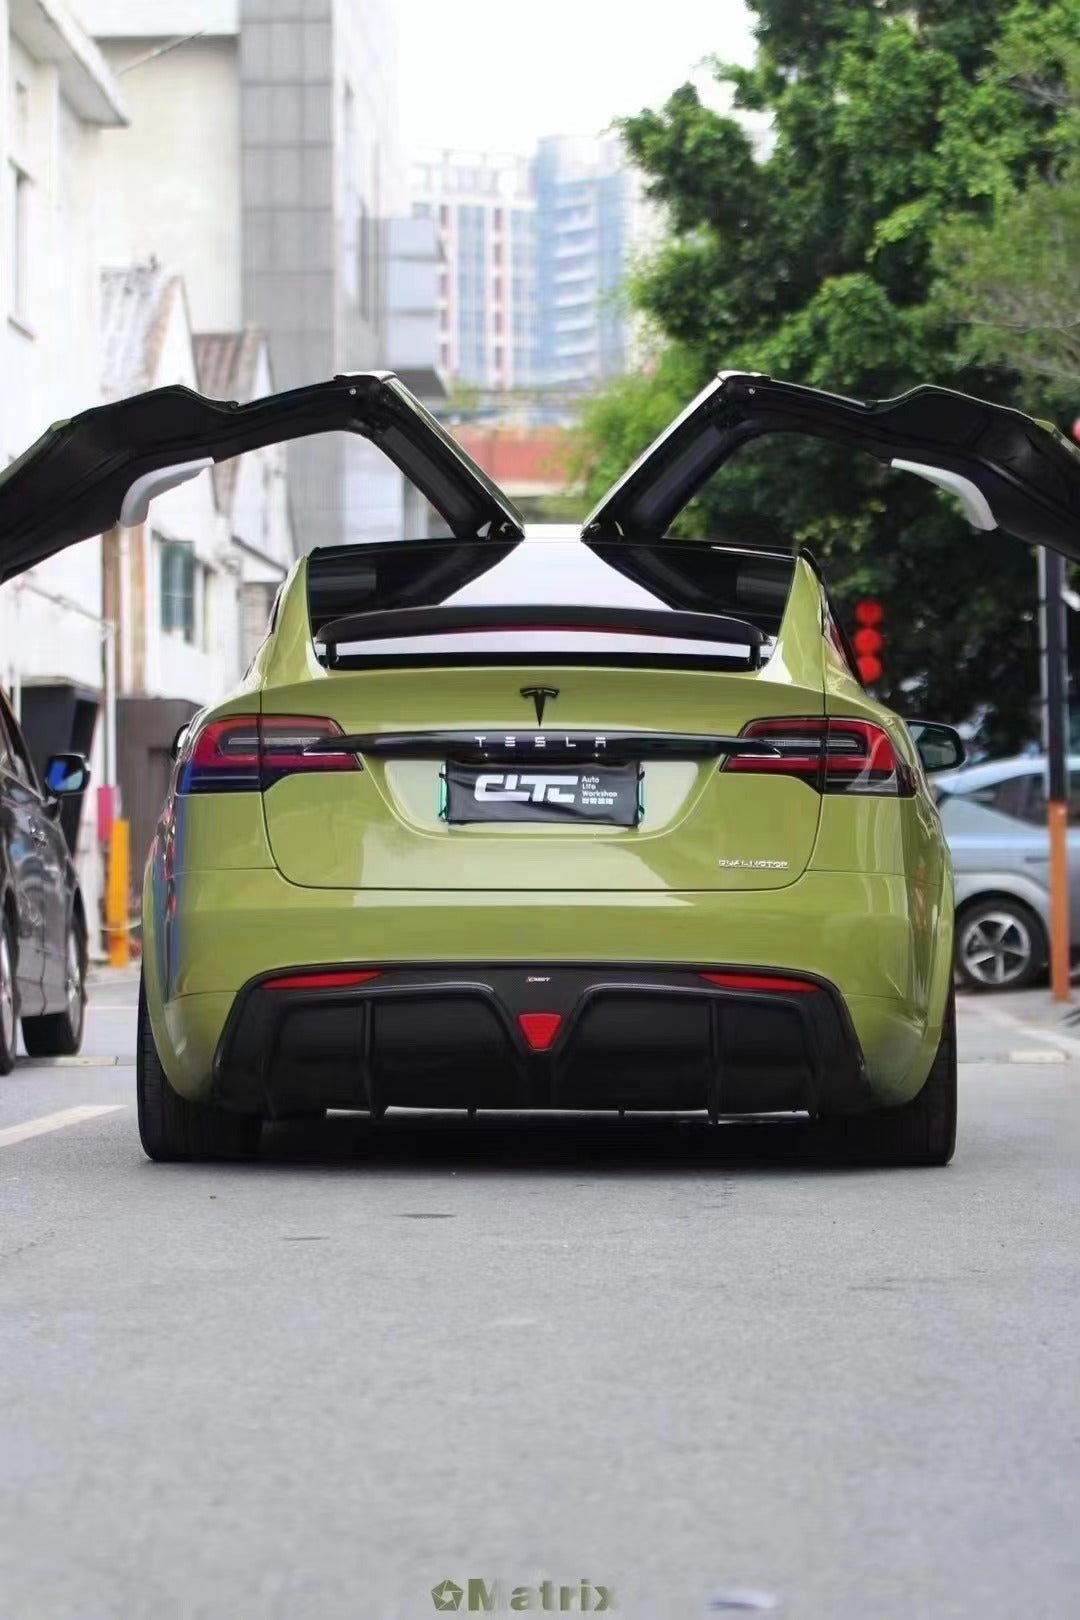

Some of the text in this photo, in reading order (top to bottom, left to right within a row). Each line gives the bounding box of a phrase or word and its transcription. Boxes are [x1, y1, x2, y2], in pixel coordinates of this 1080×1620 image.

[474, 736, 606, 748] TESLA
[582, 776, 600, 784] Auto
[582, 790, 618, 798] Workshop
